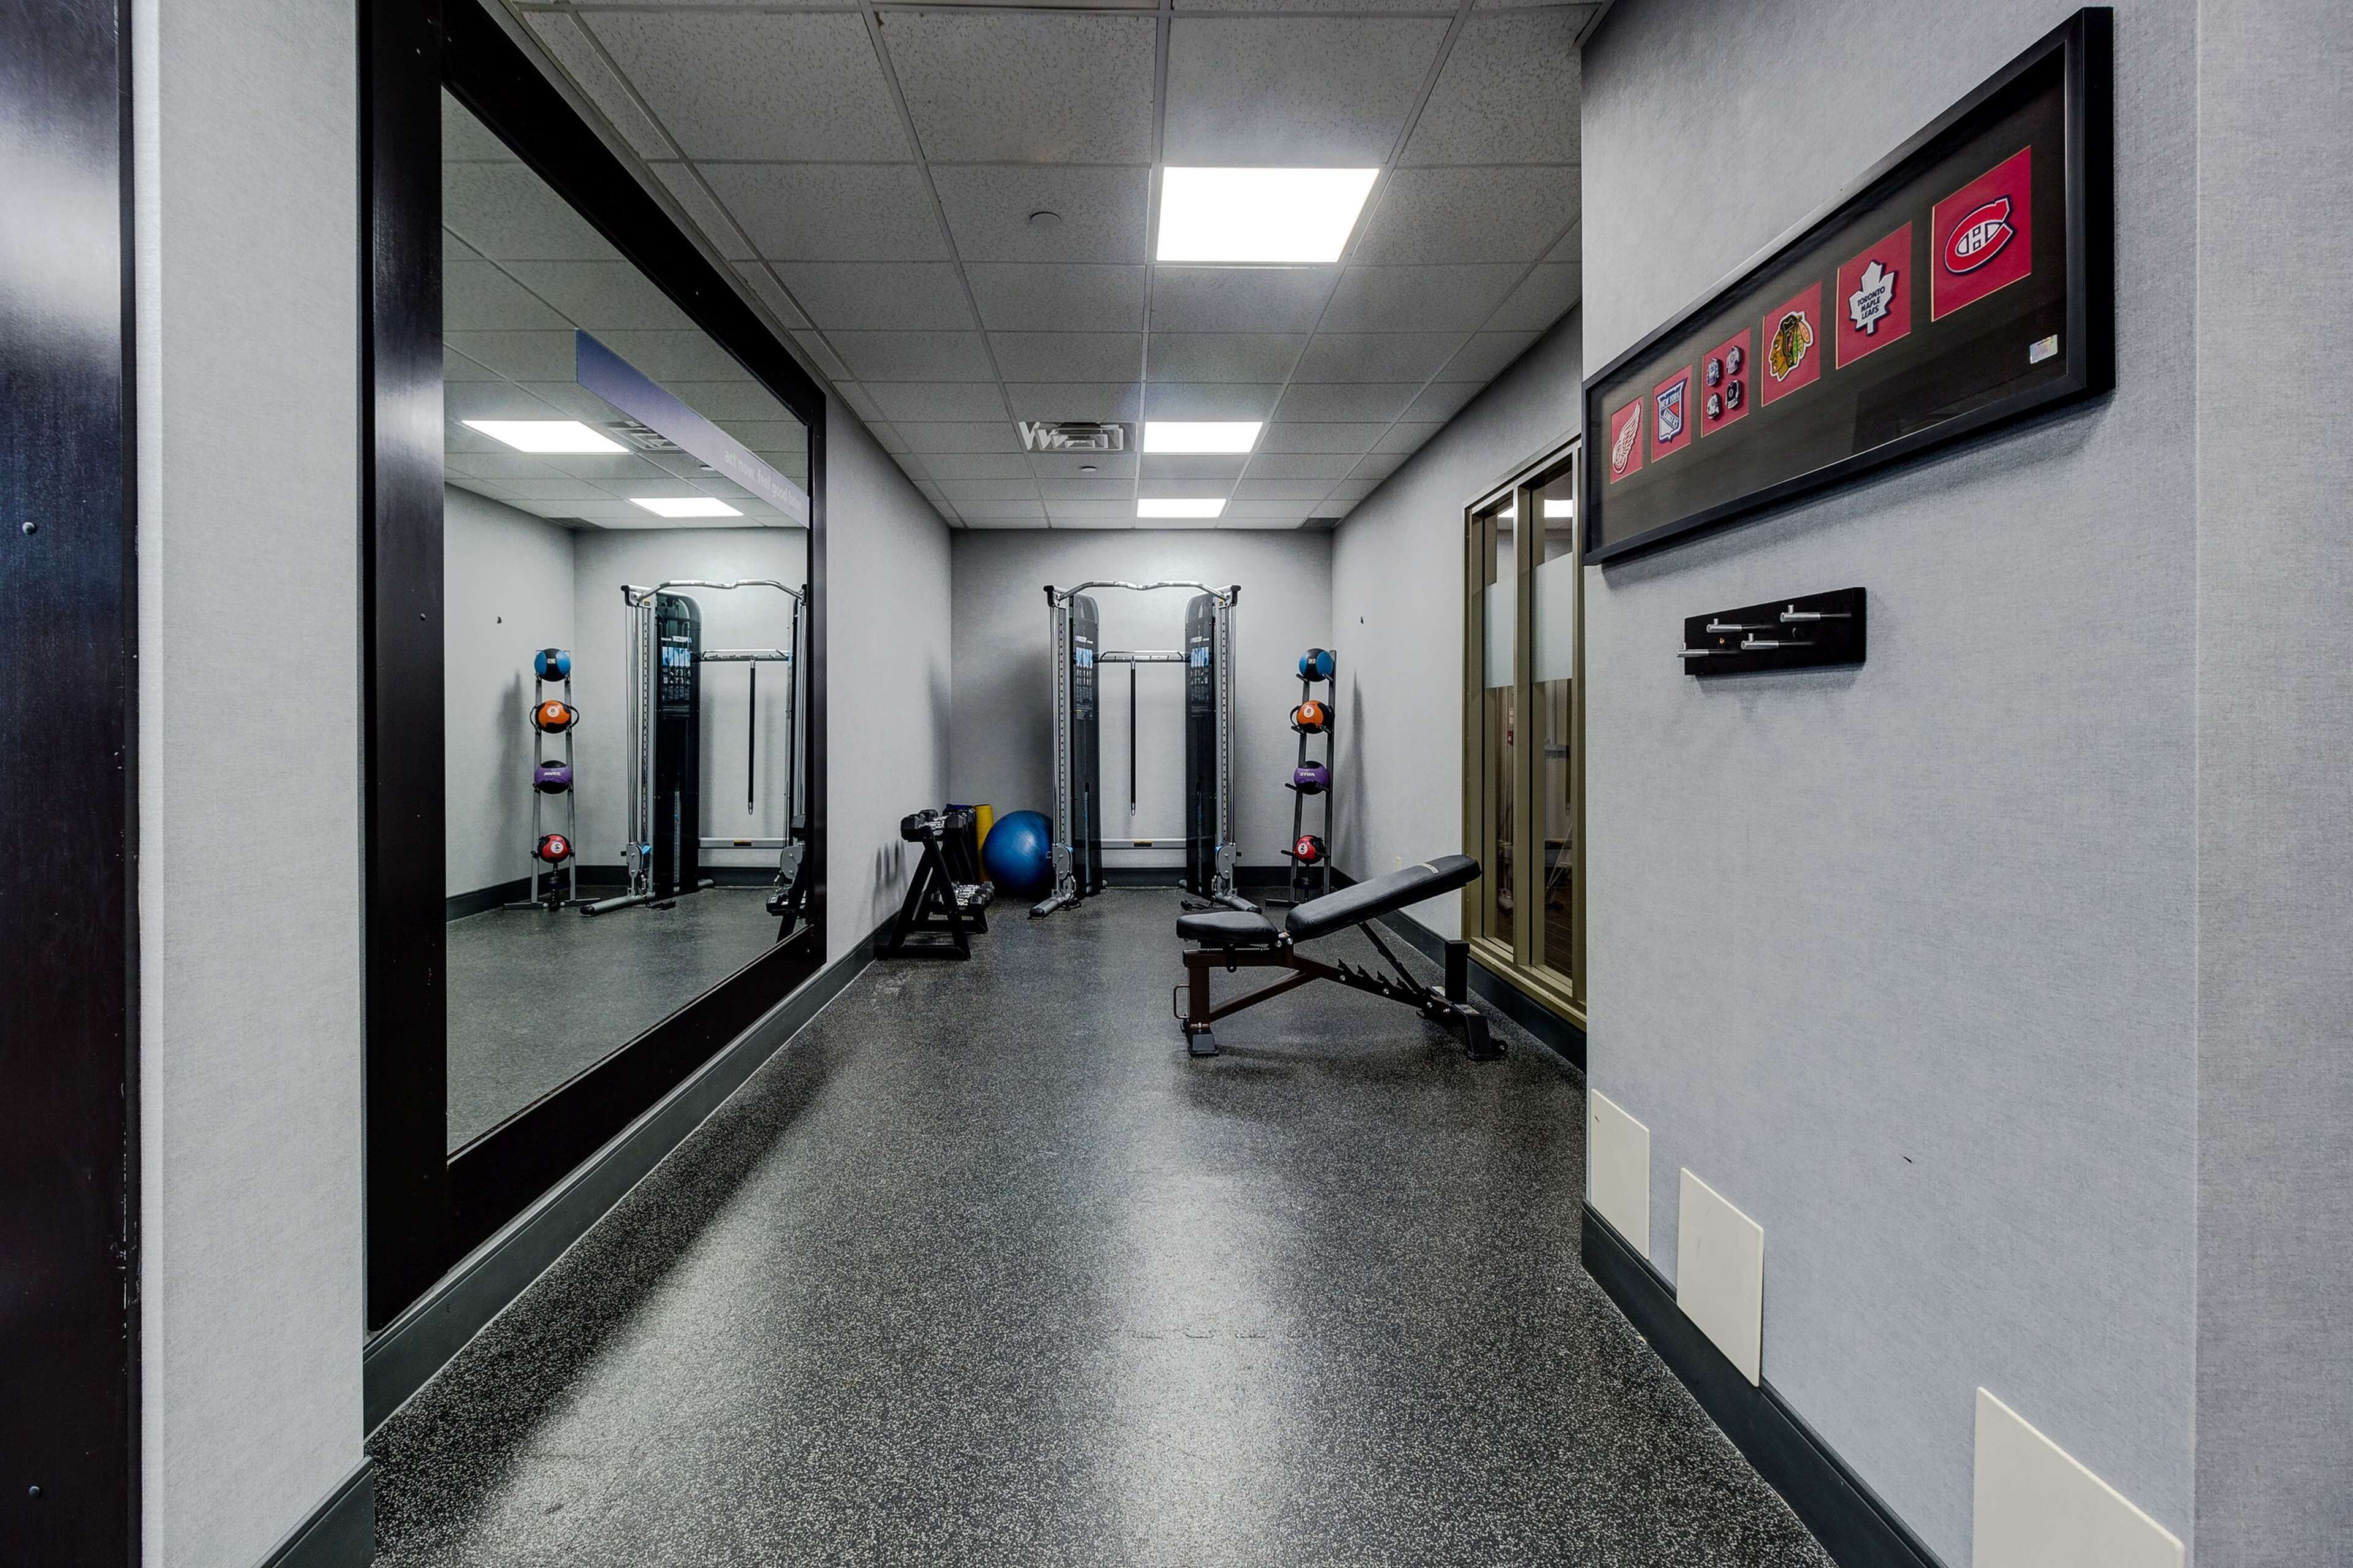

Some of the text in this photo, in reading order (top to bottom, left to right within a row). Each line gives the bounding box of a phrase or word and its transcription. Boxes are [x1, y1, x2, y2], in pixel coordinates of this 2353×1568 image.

[1857, 286, 1885, 306] TORONTO
[1860, 296, 1881, 313] MAPLE
[1861, 305, 1879, 319] LEAFS
[724, 450, 737, 469] act
[738, 460, 756, 483] now,
[757, 469, 770, 489] feel
[771, 483, 788, 502] good
